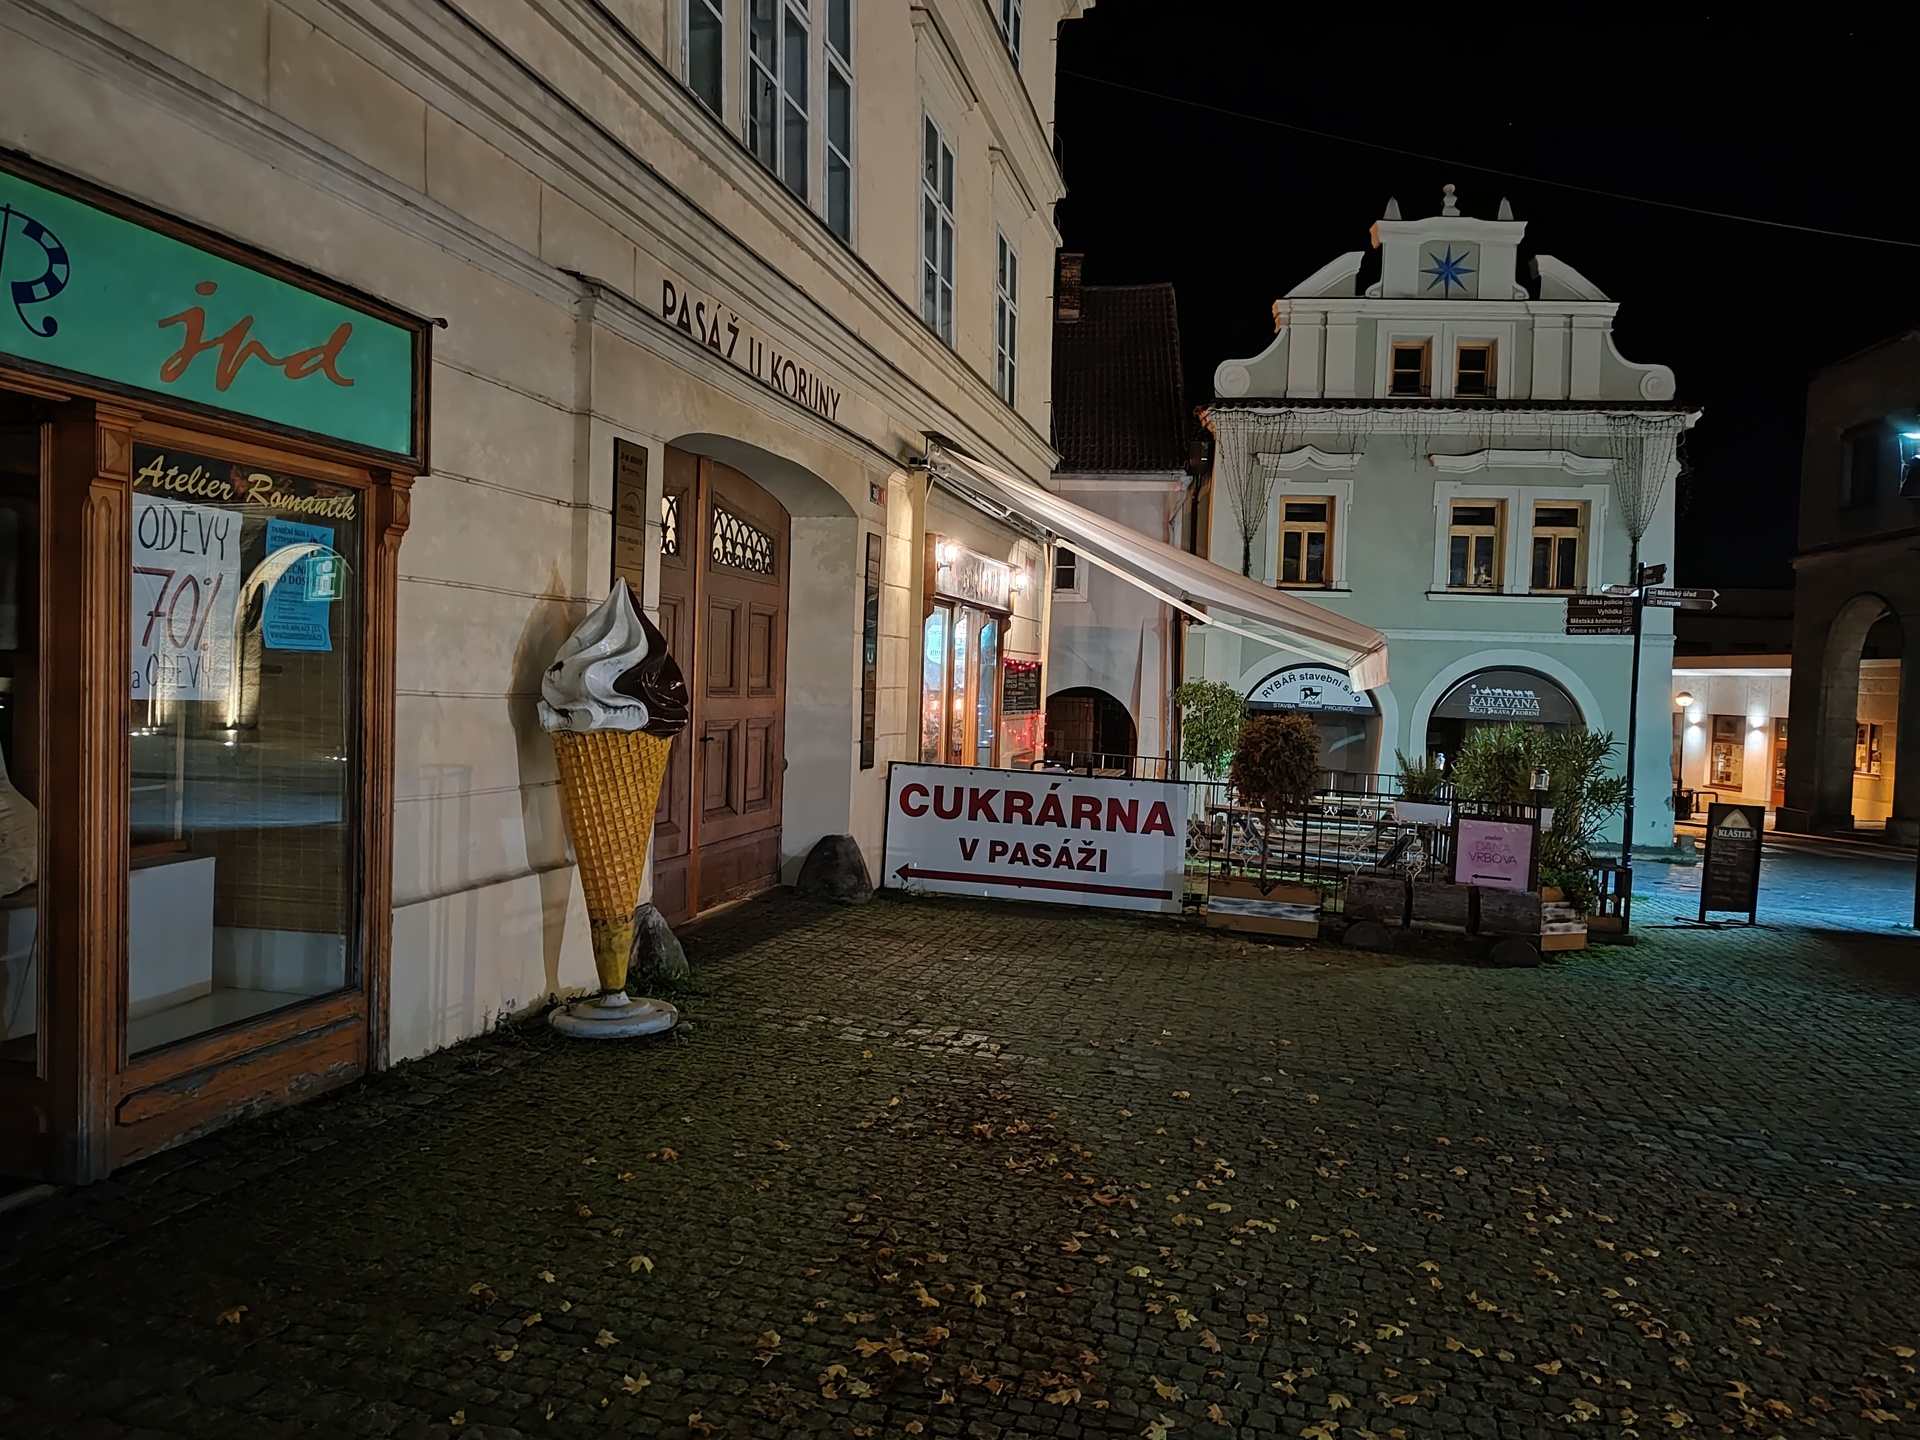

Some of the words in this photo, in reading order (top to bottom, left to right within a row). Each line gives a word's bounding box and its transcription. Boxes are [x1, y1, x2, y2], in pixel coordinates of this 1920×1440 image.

[662, 279, 741, 359] PASÁŽ
[749, 337, 763, 377] U
[770, 351, 841, 421] KORUNY
[134, 455, 234, 501] Atelier
[246, 474, 356, 521] Romantik
[138, 504, 230, 561] ODĚVY
[1657, 589, 1682, 598] Městský
[1683, 589, 1697, 598] úřad
[133, 565, 224, 651] 70%
[1578, 598, 1603, 606] Městská
[1604, 598, 1623, 607] policie
[1656, 599, 1681, 607] Muzeum
[1597, 607, 1623, 616] Vyhlídka
[1570, 617, 1594, 625] Městská
[1595, 617, 1622, 625] knihovna
[1598, 627, 1622, 635] Ludmily
[1261, 671, 1297, 699] RYBÁŘ
[1299, 672, 1345, 688] stavební
[1324, 705, 1355, 713] PROJEKCE
[1469, 696, 1540, 709] KARAVANA
[898, 783, 1176, 837] CUKRÁRNA
[1718, 828, 1751, 839] KLÁŠTER
[1475, 841, 1512, 854] DANA
[958, 837, 980, 861] V
[988, 838, 1108, 873] PASÁŽI
